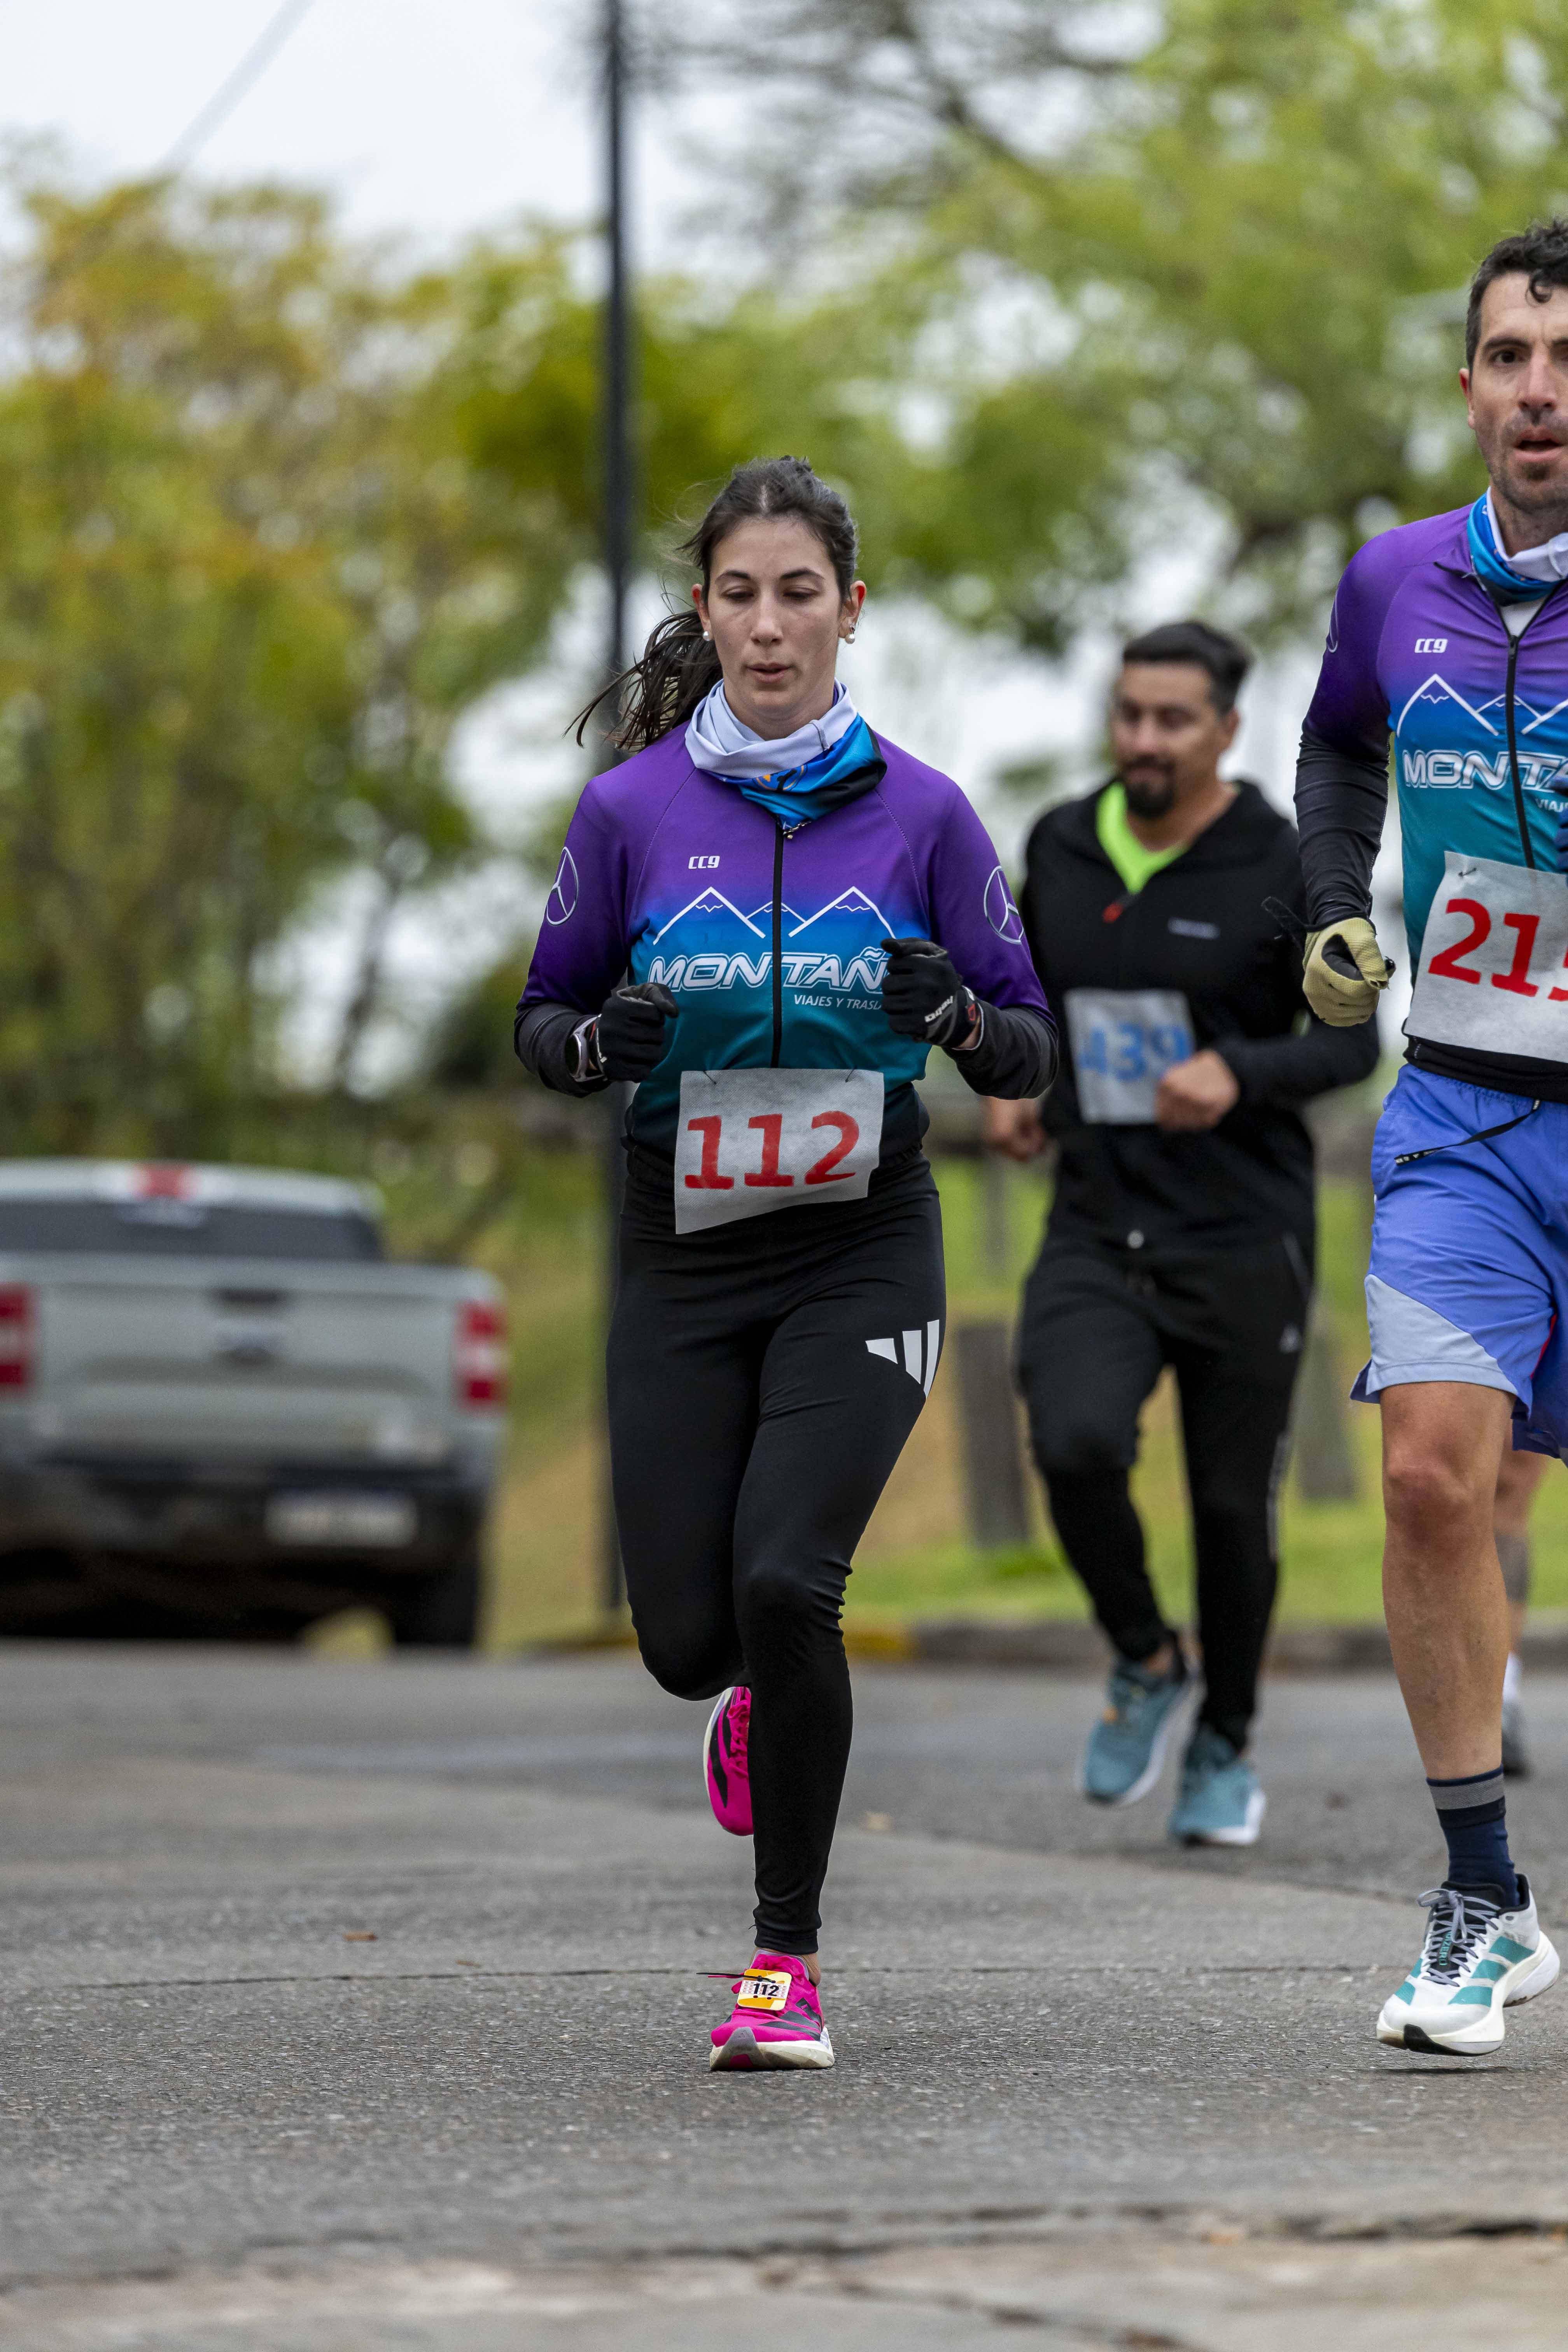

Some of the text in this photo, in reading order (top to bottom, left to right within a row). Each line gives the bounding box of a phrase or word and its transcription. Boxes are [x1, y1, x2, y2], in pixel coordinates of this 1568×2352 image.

[1414, 638, 1448, 653] CC9
[688, 856, 720, 869] CC9
[648, 946, 889, 994] MONTAÑ
[794, 994, 833, 1007] VIAJES
[836, 998, 845, 1008] Y
[684, 1110, 859, 1190] 112
[753, 1983, 779, 1997] 112
